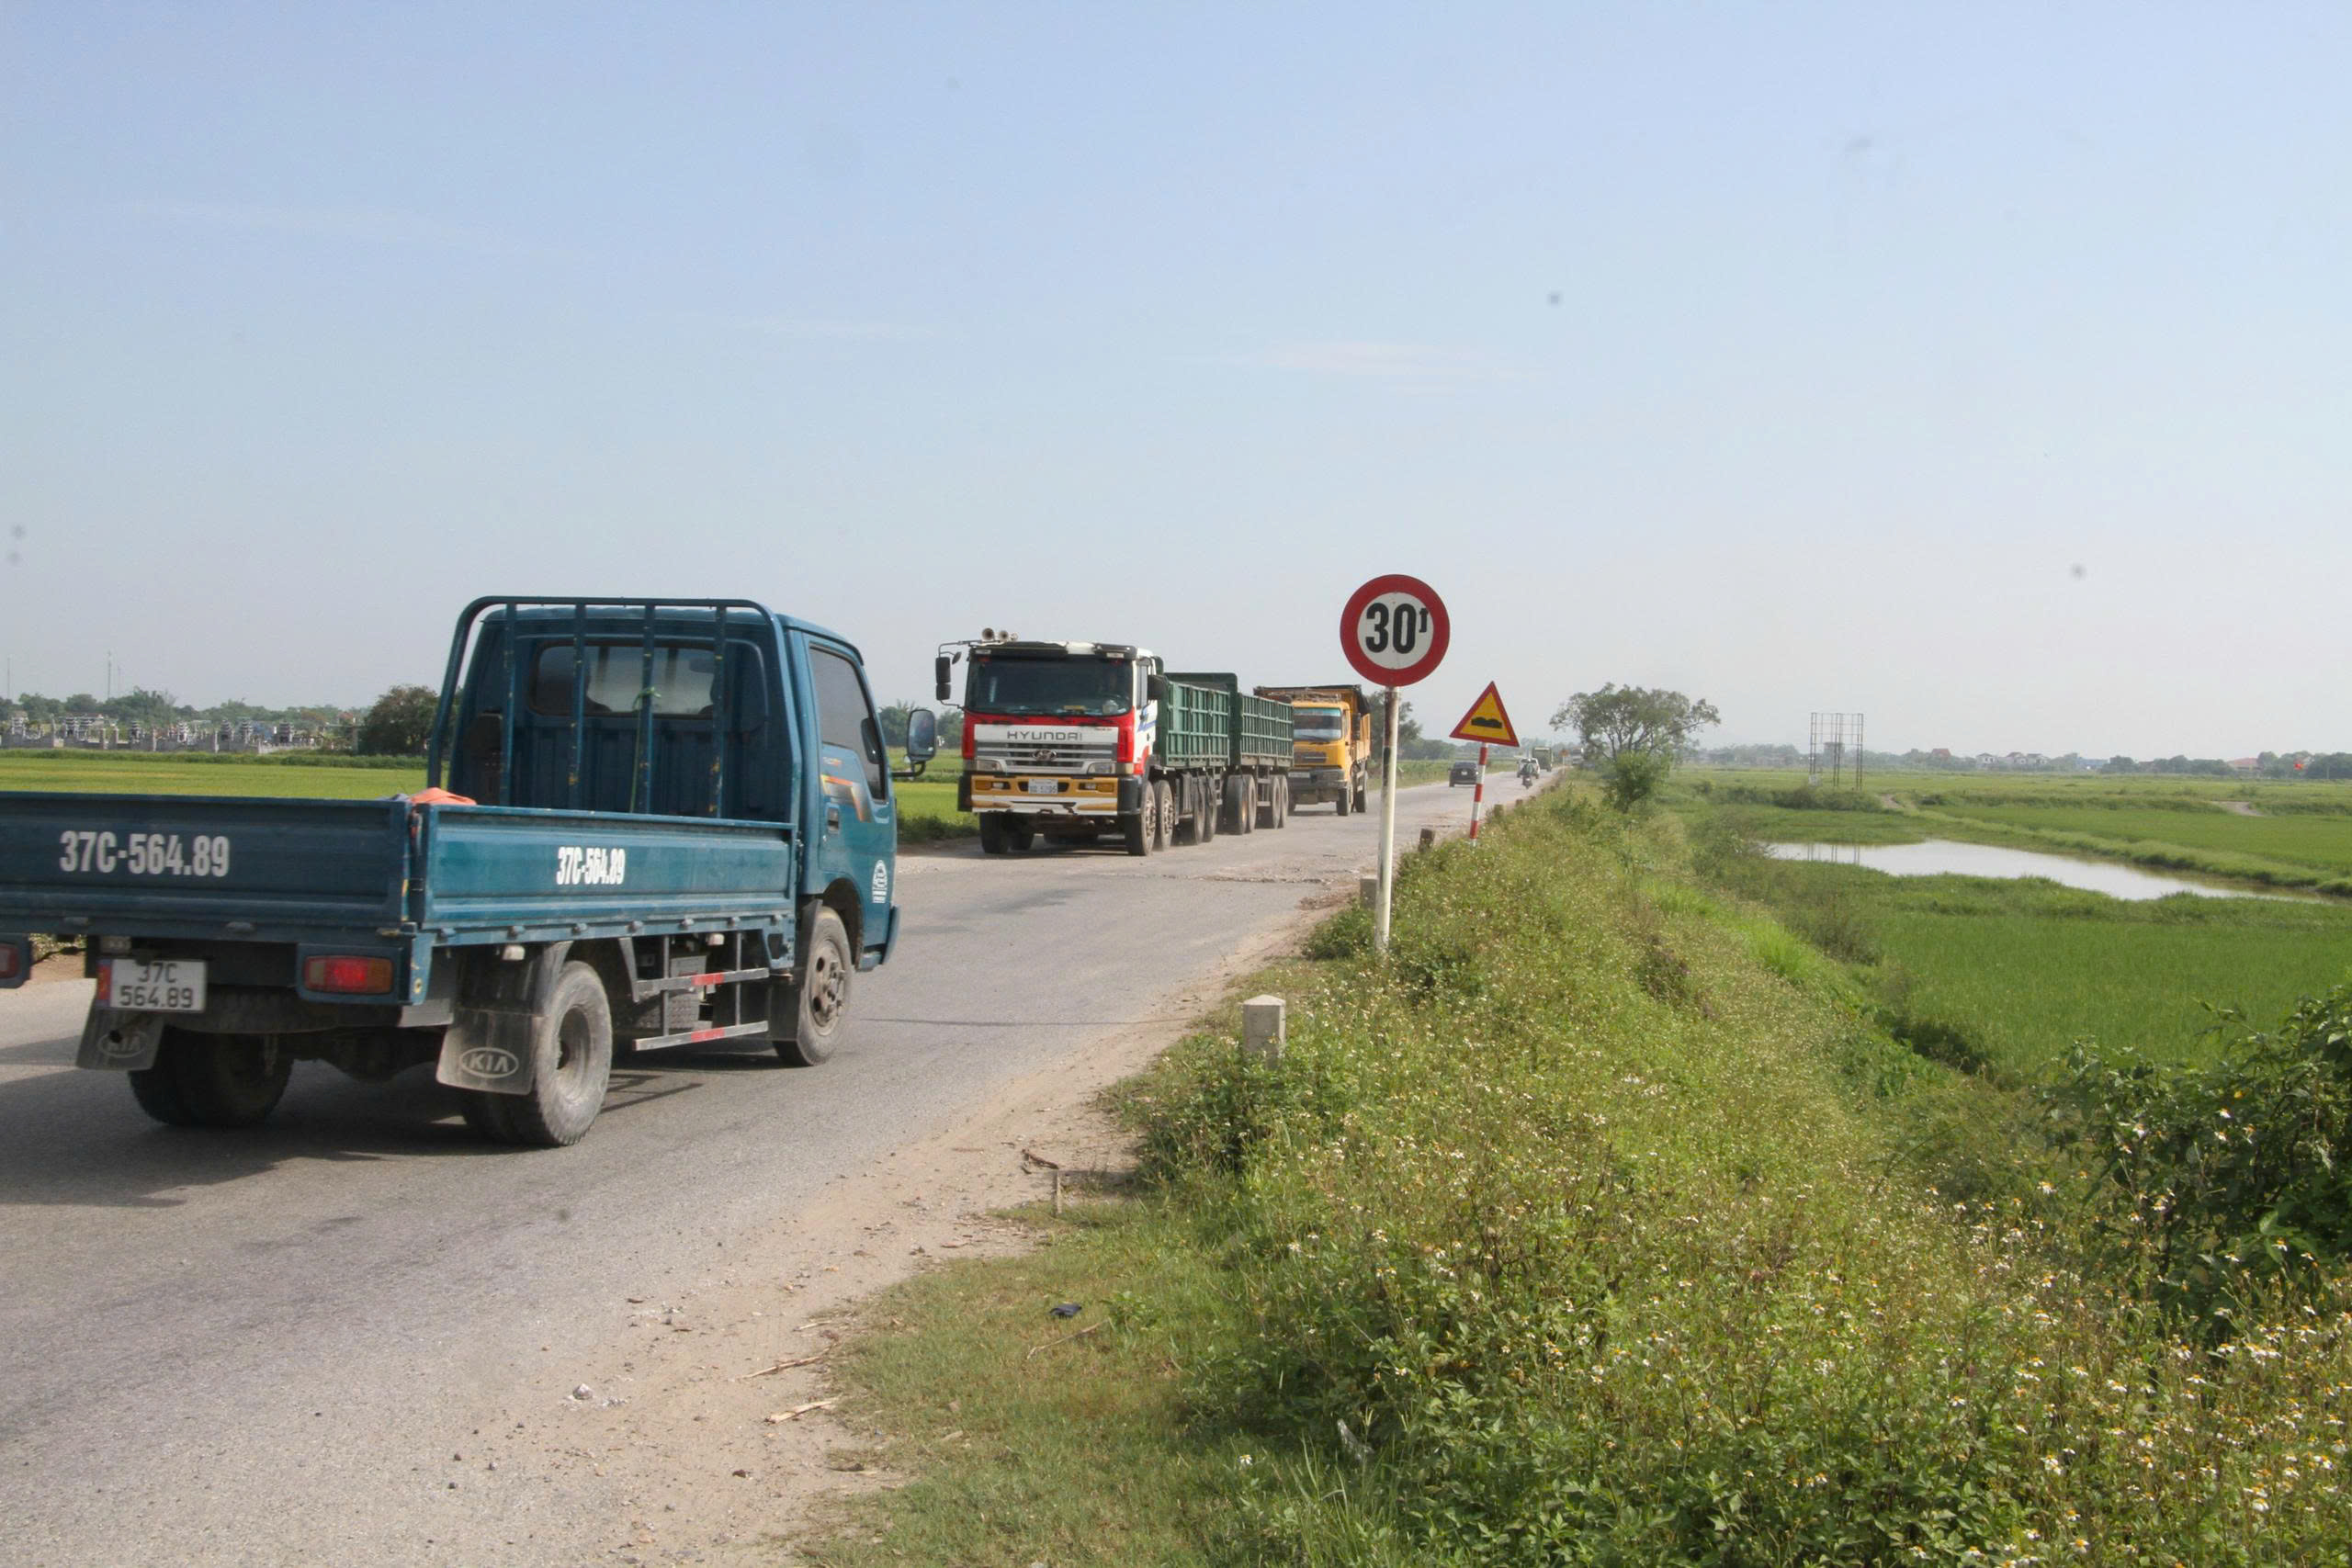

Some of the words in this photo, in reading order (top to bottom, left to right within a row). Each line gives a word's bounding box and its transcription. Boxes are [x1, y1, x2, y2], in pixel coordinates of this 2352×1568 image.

[1007, 731, 1082, 741] HYUNDAI
[59, 830, 230, 877] 37C-564.89
[557, 847, 626, 885] 37C-564.89
[137, 962, 177, 983] 37C
[119, 985, 193, 1009] 564.89
[469, 1053, 508, 1073] KIA
